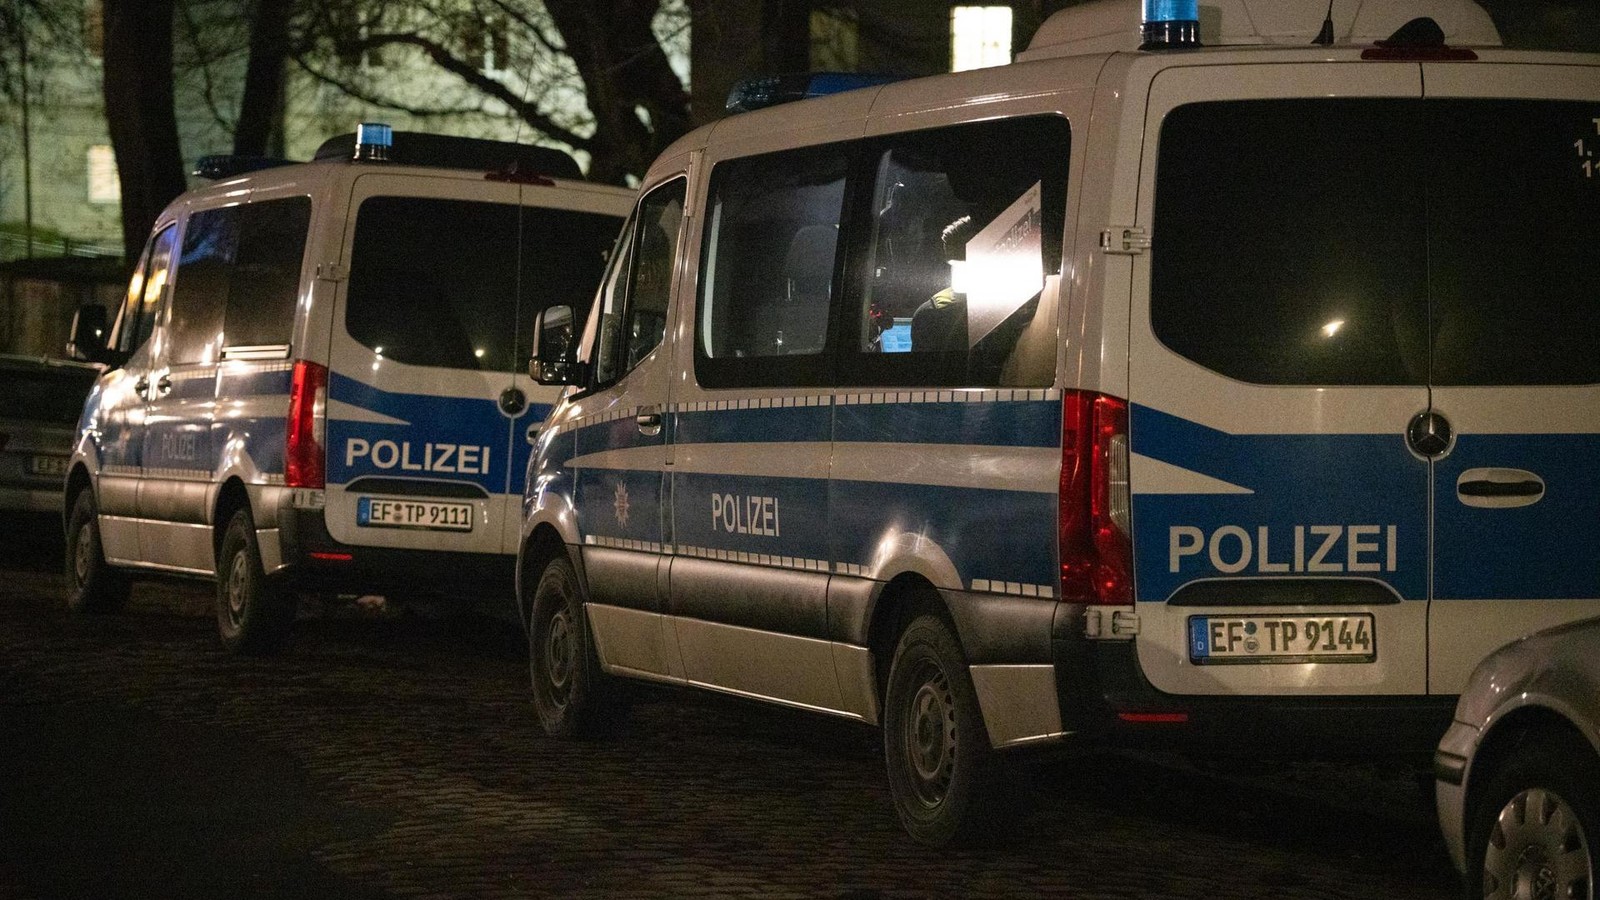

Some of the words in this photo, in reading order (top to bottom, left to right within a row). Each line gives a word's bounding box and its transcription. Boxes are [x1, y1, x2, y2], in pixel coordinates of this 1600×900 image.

[345, 437, 491, 475] POLIZEI
[371, 502, 392, 520] EF
[406, 504, 425, 522] TP
[430, 505, 470, 526] 9111
[711, 492, 780, 537] POLIZEI
[1169, 524, 1397, 573] POLIZEI
[1210, 621, 1243, 652] EF
[1264, 621, 1298, 652] TP
[1305, 620, 1370, 651] 9144
